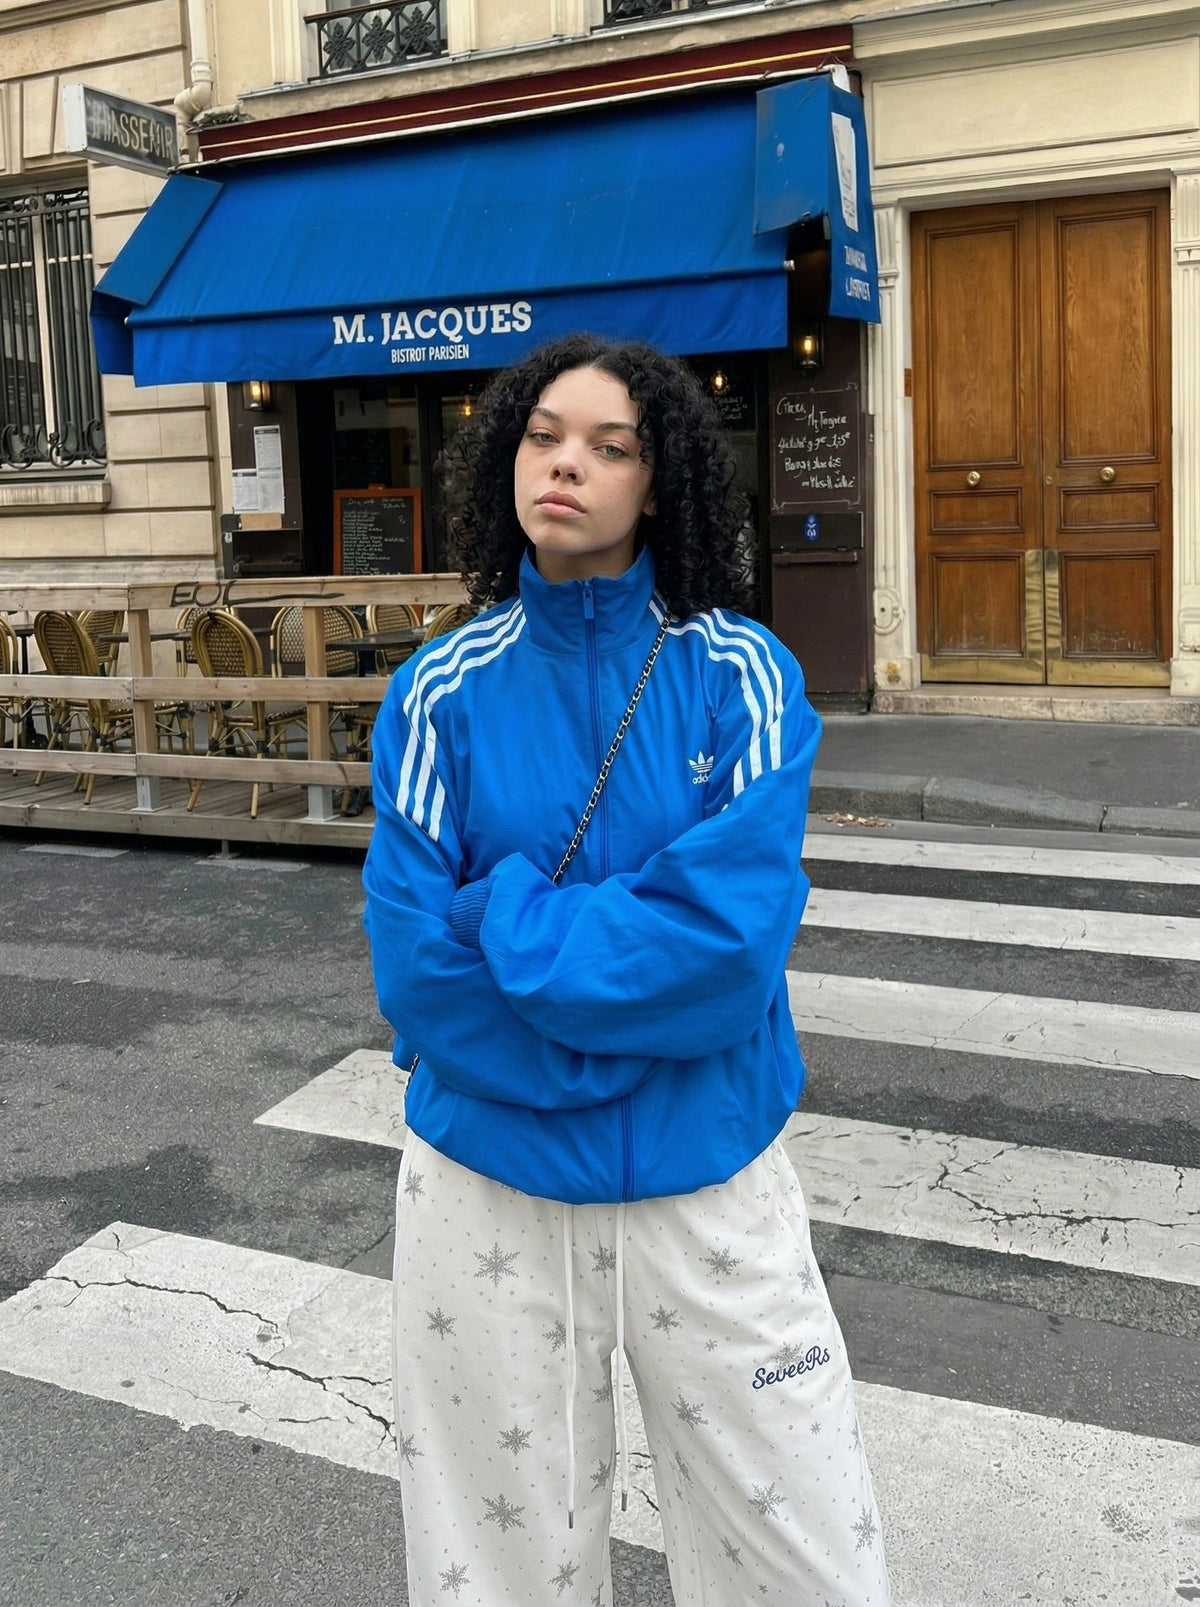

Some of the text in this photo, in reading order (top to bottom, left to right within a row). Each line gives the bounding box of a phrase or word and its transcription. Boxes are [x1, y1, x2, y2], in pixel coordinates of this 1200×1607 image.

[333, 301, 532, 345] M. JACQUES
[391, 344, 470, 364] BISTROT PARISIEN
